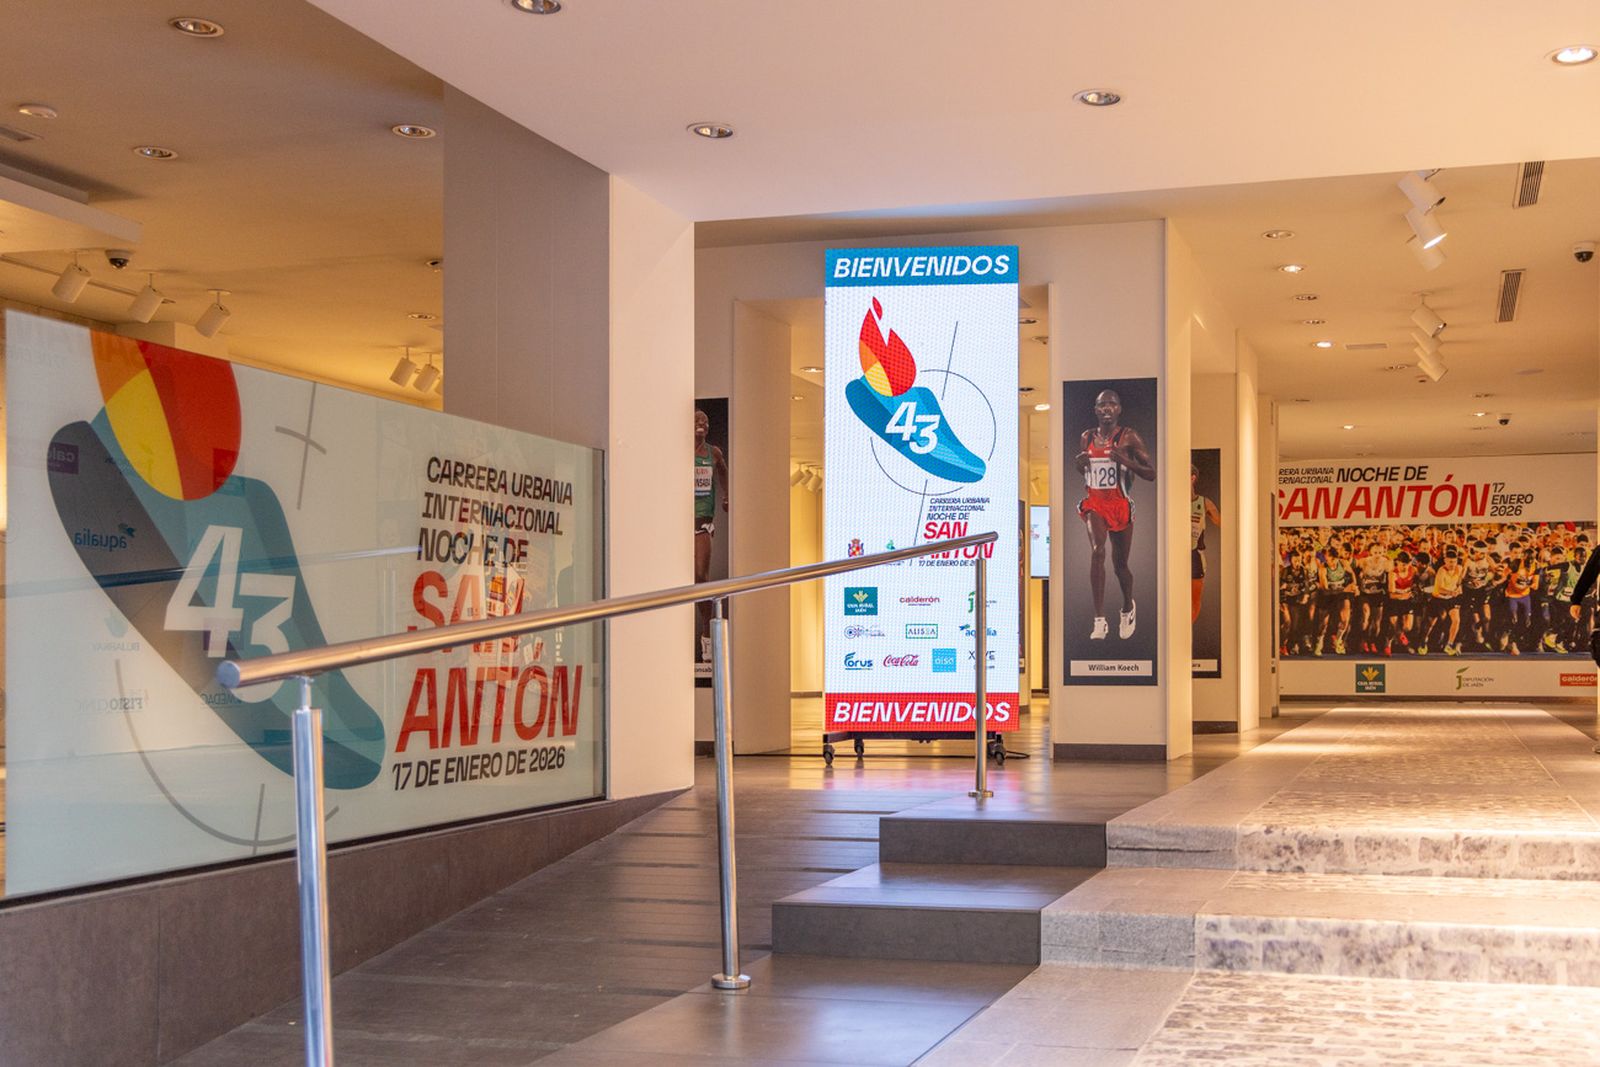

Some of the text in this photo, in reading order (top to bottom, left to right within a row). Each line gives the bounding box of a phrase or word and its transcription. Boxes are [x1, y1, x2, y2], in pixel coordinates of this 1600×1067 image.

[833, 255, 1010, 279] BIENVENIDOS
[885, 401, 940, 455] 43
[427, 456, 573, 506] CARRERA URBANA
[1336, 466, 1429, 483] NOCHE DE
[1492, 482, 1505, 493] 17
[1343, 473, 1491, 519] ANTÓN
[1489, 505, 1522, 517] 2026
[1491, 493, 1534, 505] ENERO
[422, 491, 563, 536] INTERNACIONAL
[926, 512, 970, 520] NOCHE DE
[923, 521, 968, 540] SAN
[417, 527, 530, 568] NOCHE DE
[395, 640, 583, 753] ANTÓN
[392, 745, 566, 791] 17 DE ENERO DE 2026
